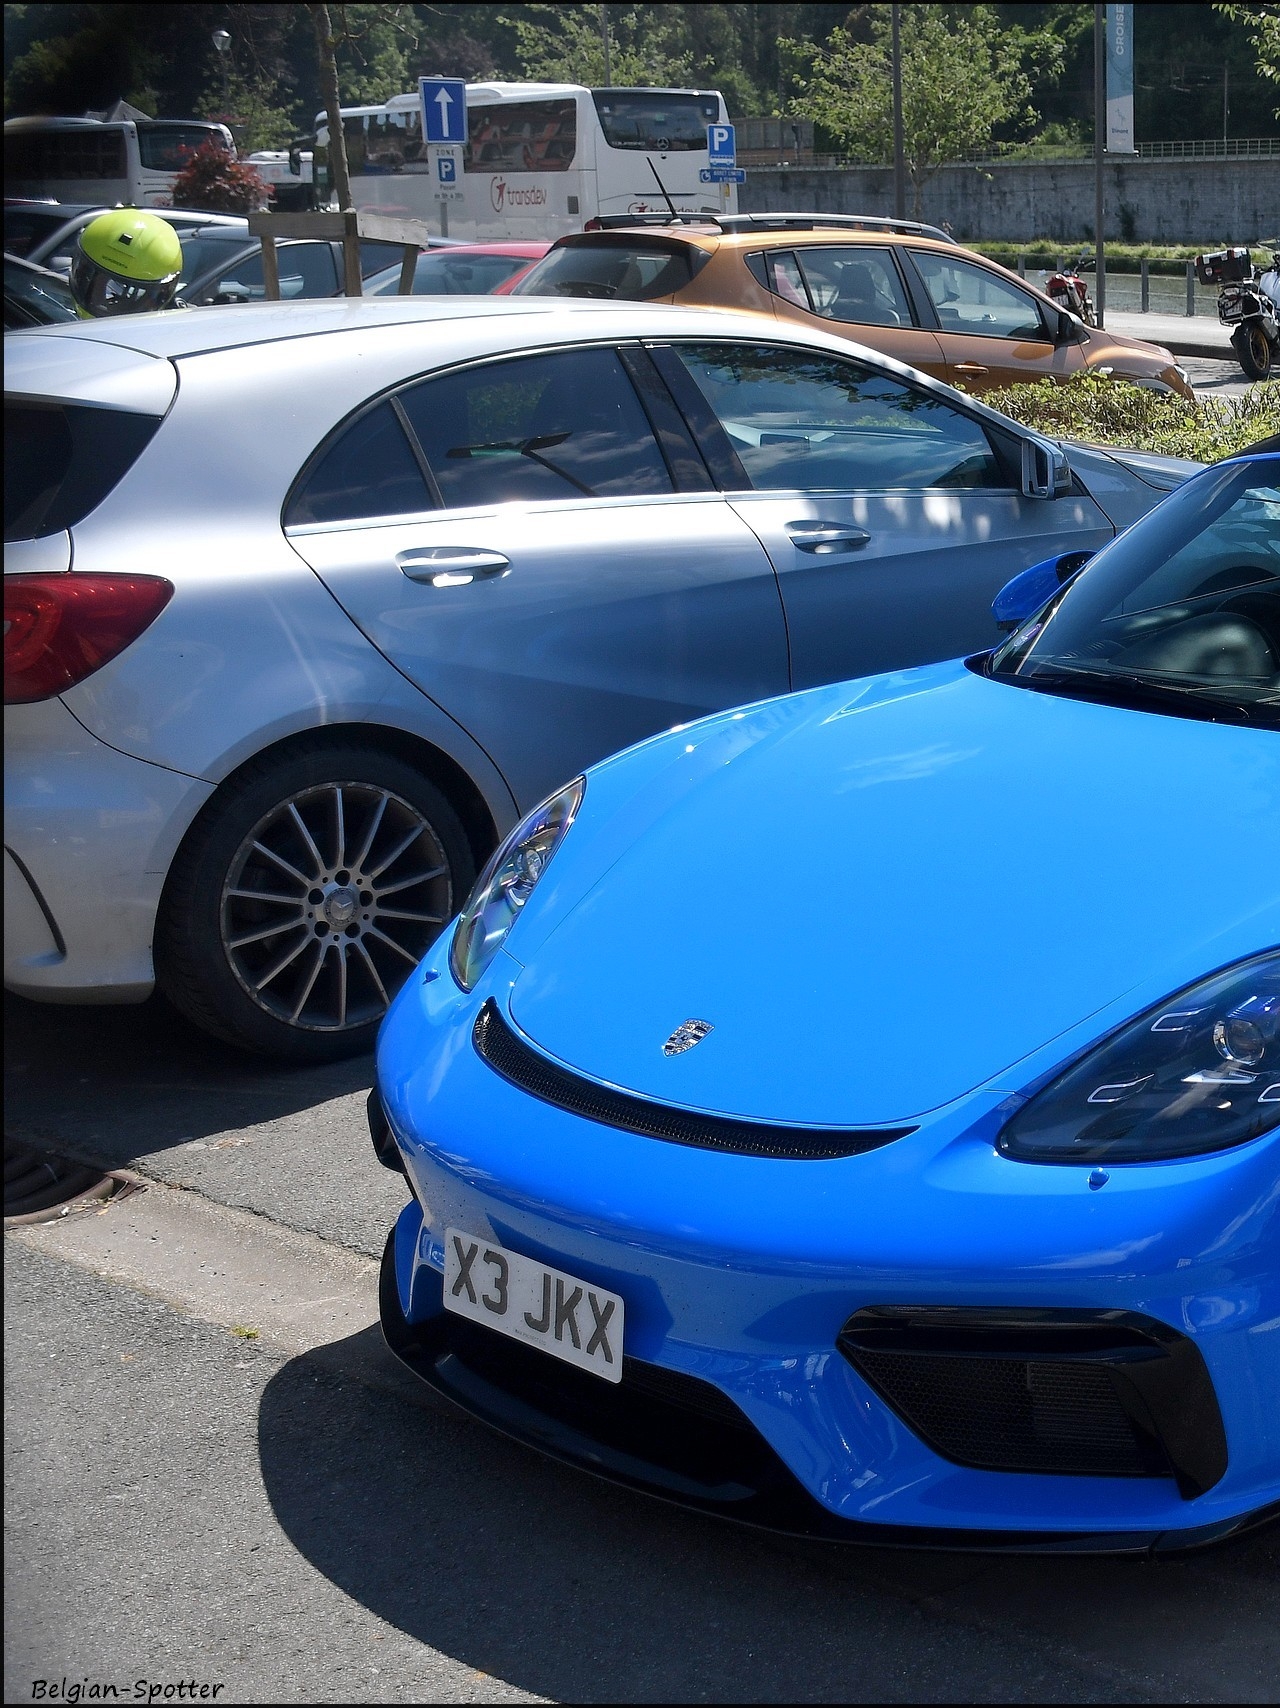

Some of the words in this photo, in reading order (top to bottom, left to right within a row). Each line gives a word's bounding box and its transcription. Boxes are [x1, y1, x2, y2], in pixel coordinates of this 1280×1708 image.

[713, 128, 729, 151] P
[507, 185, 547, 206] transdev
[451, 1236, 509, 1316] X3
[523, 1272, 616, 1364] JKX
